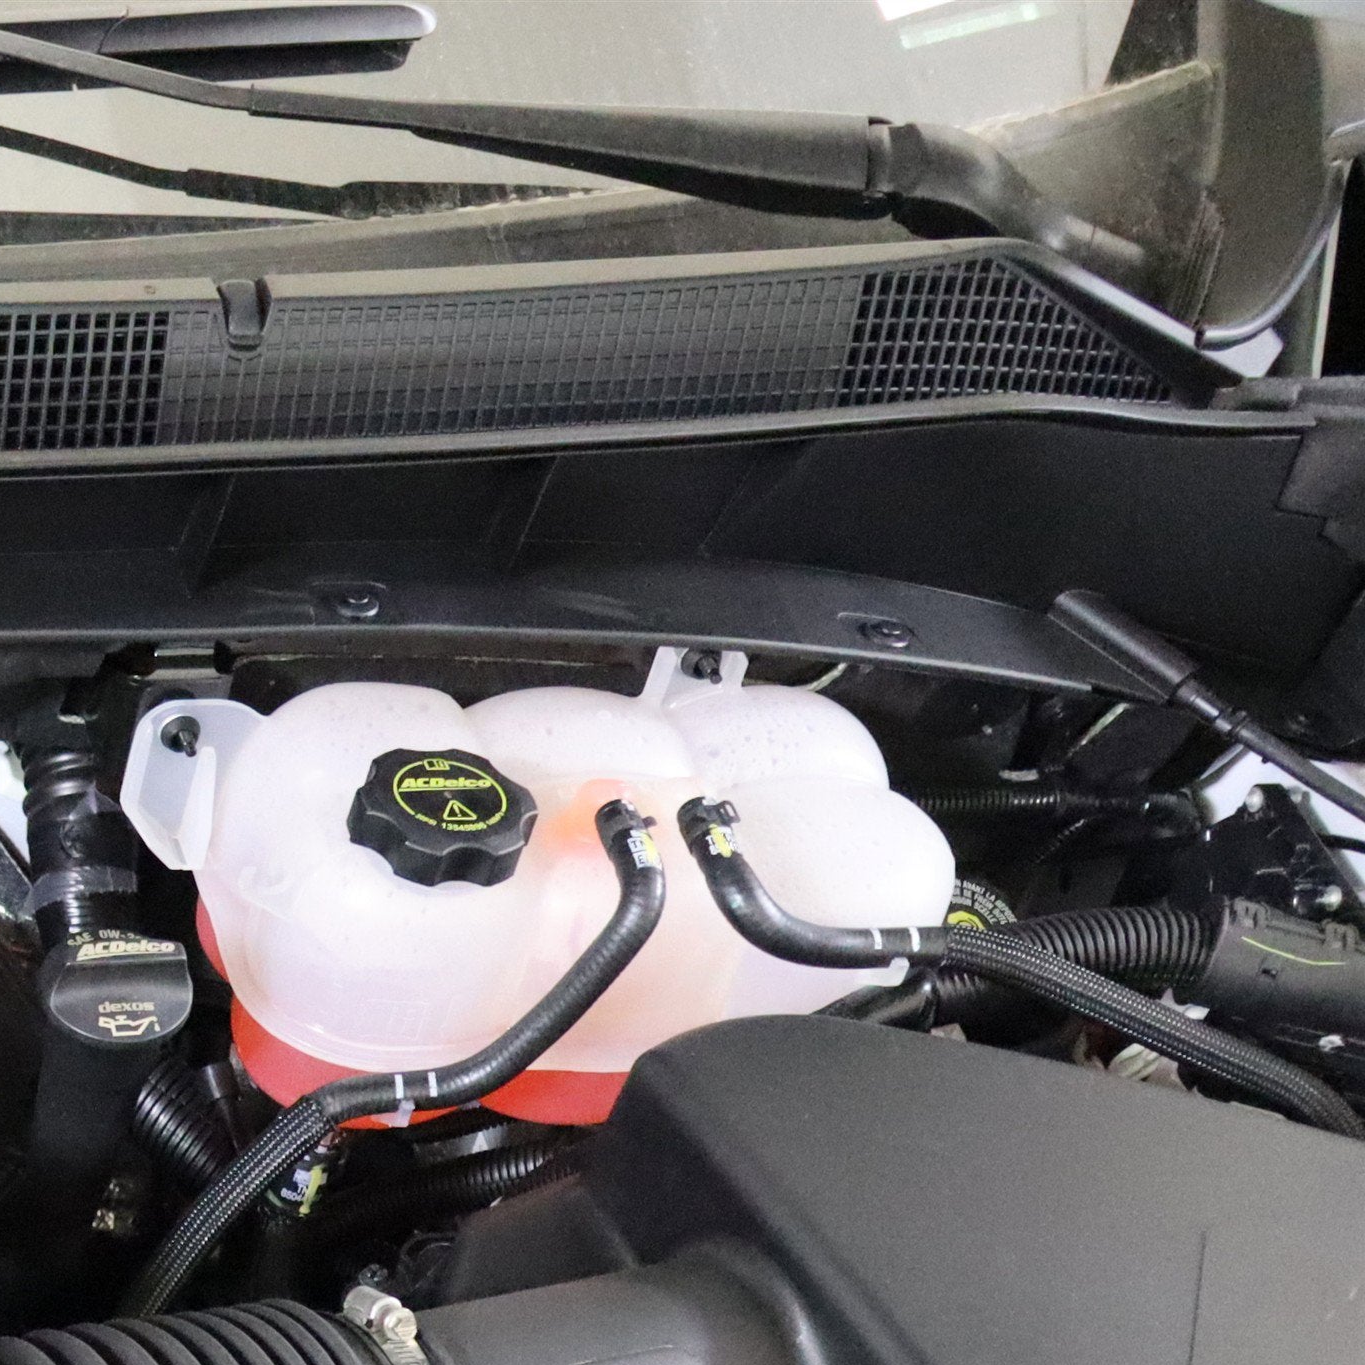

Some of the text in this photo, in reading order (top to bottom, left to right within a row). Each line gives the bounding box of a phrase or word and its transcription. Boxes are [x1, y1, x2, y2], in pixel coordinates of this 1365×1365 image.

[400, 777, 492, 789] ACDelco
[986, 891, 996, 902] LA
[67, 931, 94, 946] SAE
[77, 939, 175, 957] ACDelco
[98, 1001, 155, 1013] dexos
